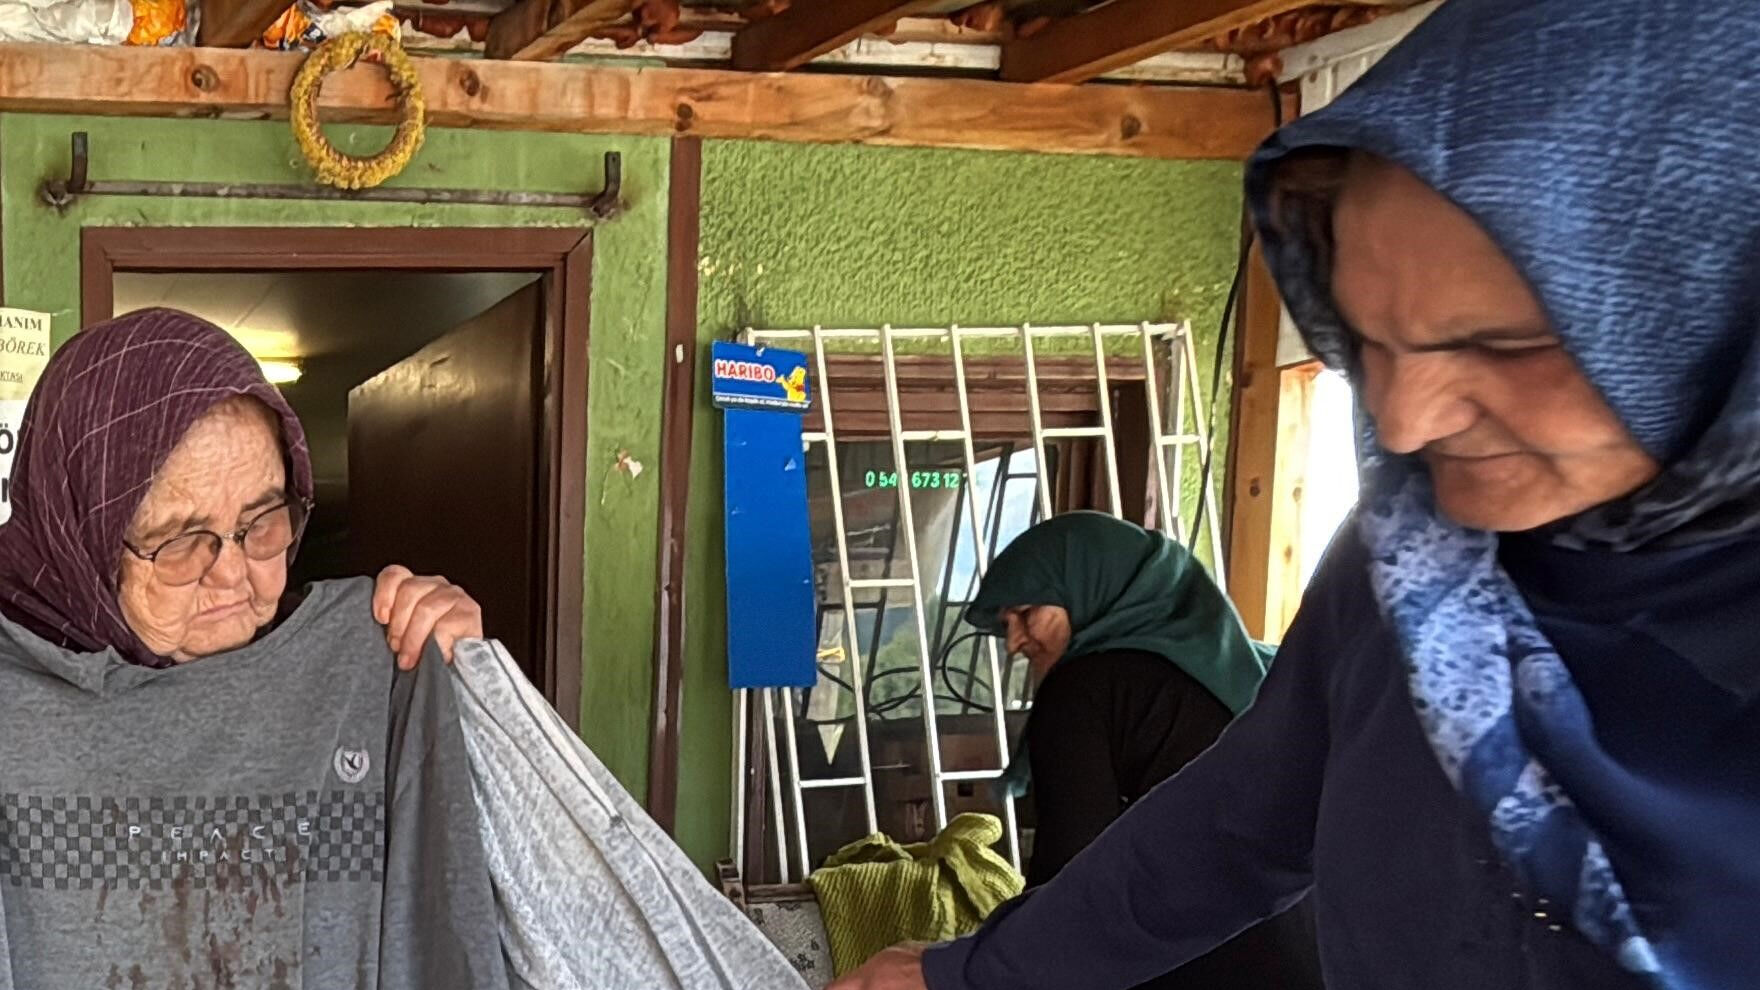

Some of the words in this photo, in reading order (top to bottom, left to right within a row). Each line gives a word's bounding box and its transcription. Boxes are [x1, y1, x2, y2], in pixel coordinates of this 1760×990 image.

[715, 360, 776, 382] HARIBO
[865, 470, 876, 488] 0
[879, 471, 898, 488] 54
[911, 471, 941, 488] 673
[943, 472, 960, 488] 12
[162, 848, 275, 863] IMPACT
